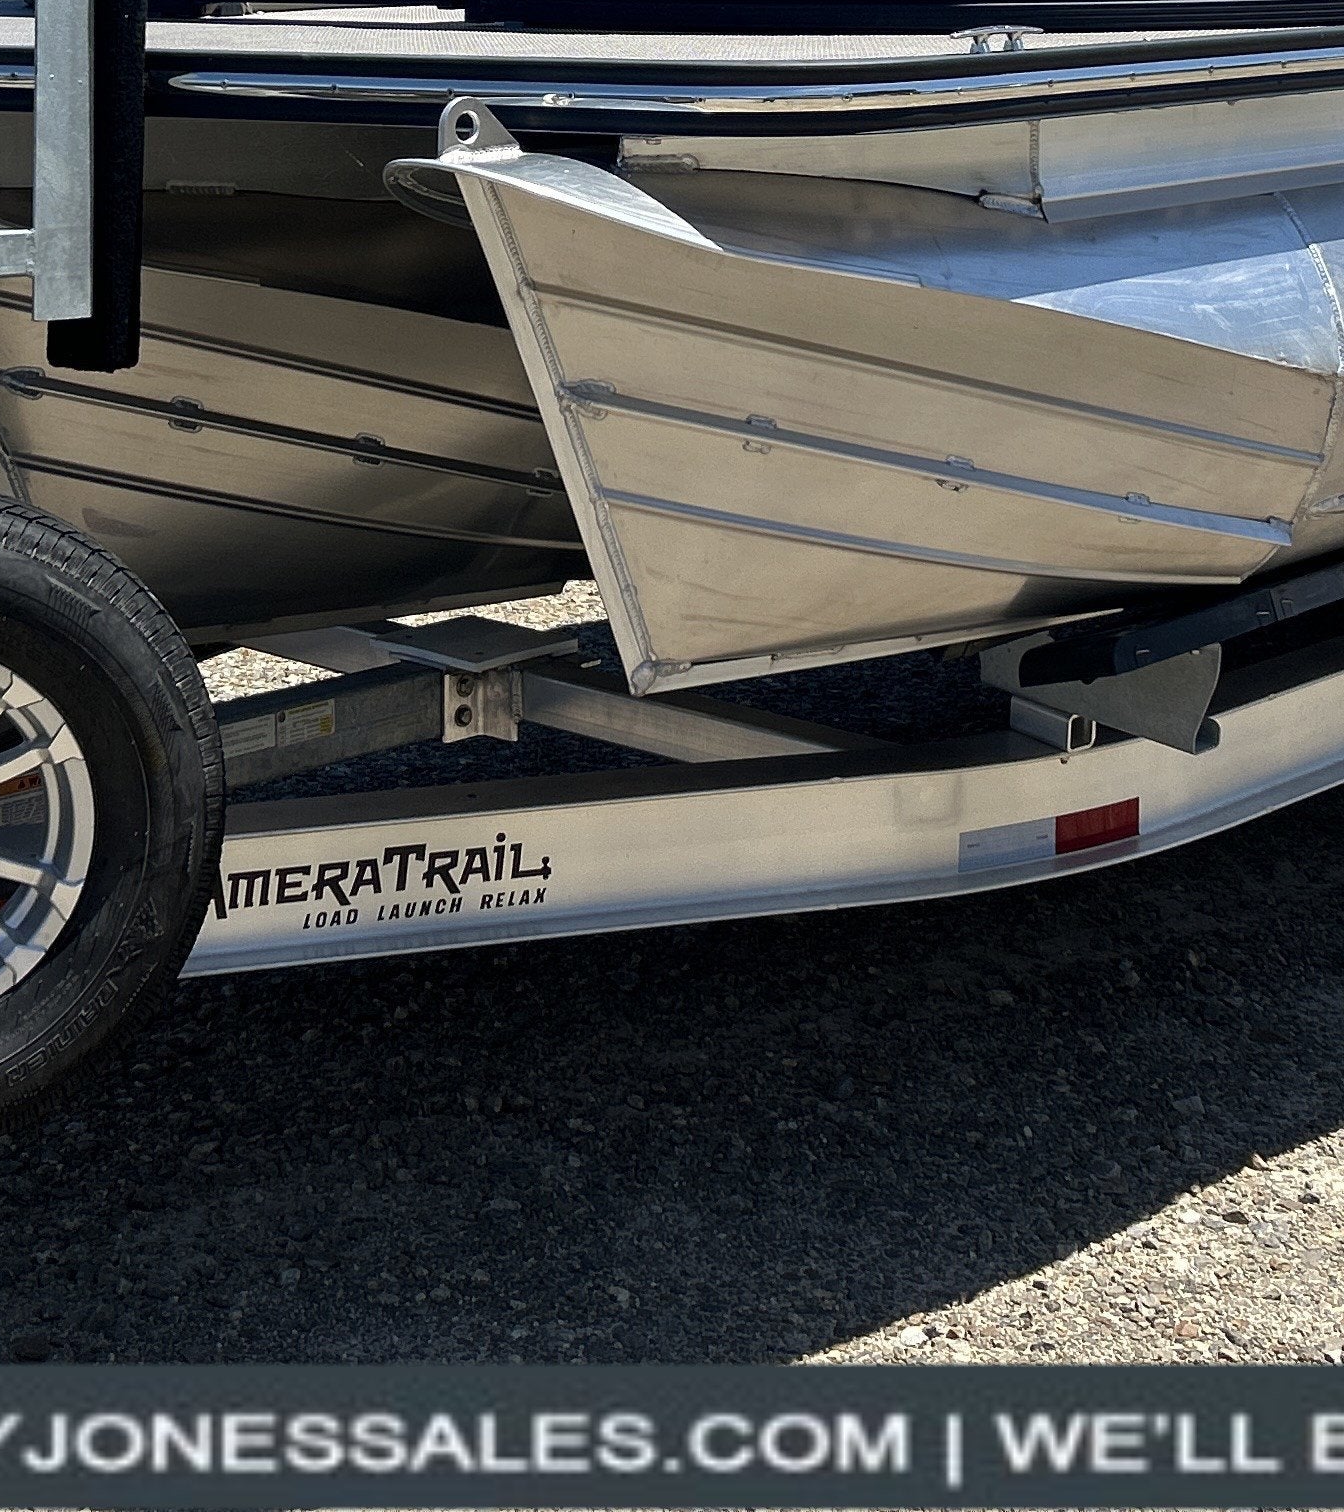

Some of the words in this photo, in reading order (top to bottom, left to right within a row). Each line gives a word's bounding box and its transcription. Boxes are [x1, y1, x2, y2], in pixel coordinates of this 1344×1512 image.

[302, 908, 359, 930] LOAD
[377, 896, 463, 922] LAUNCH
[480, 887, 548, 910] RELAX
